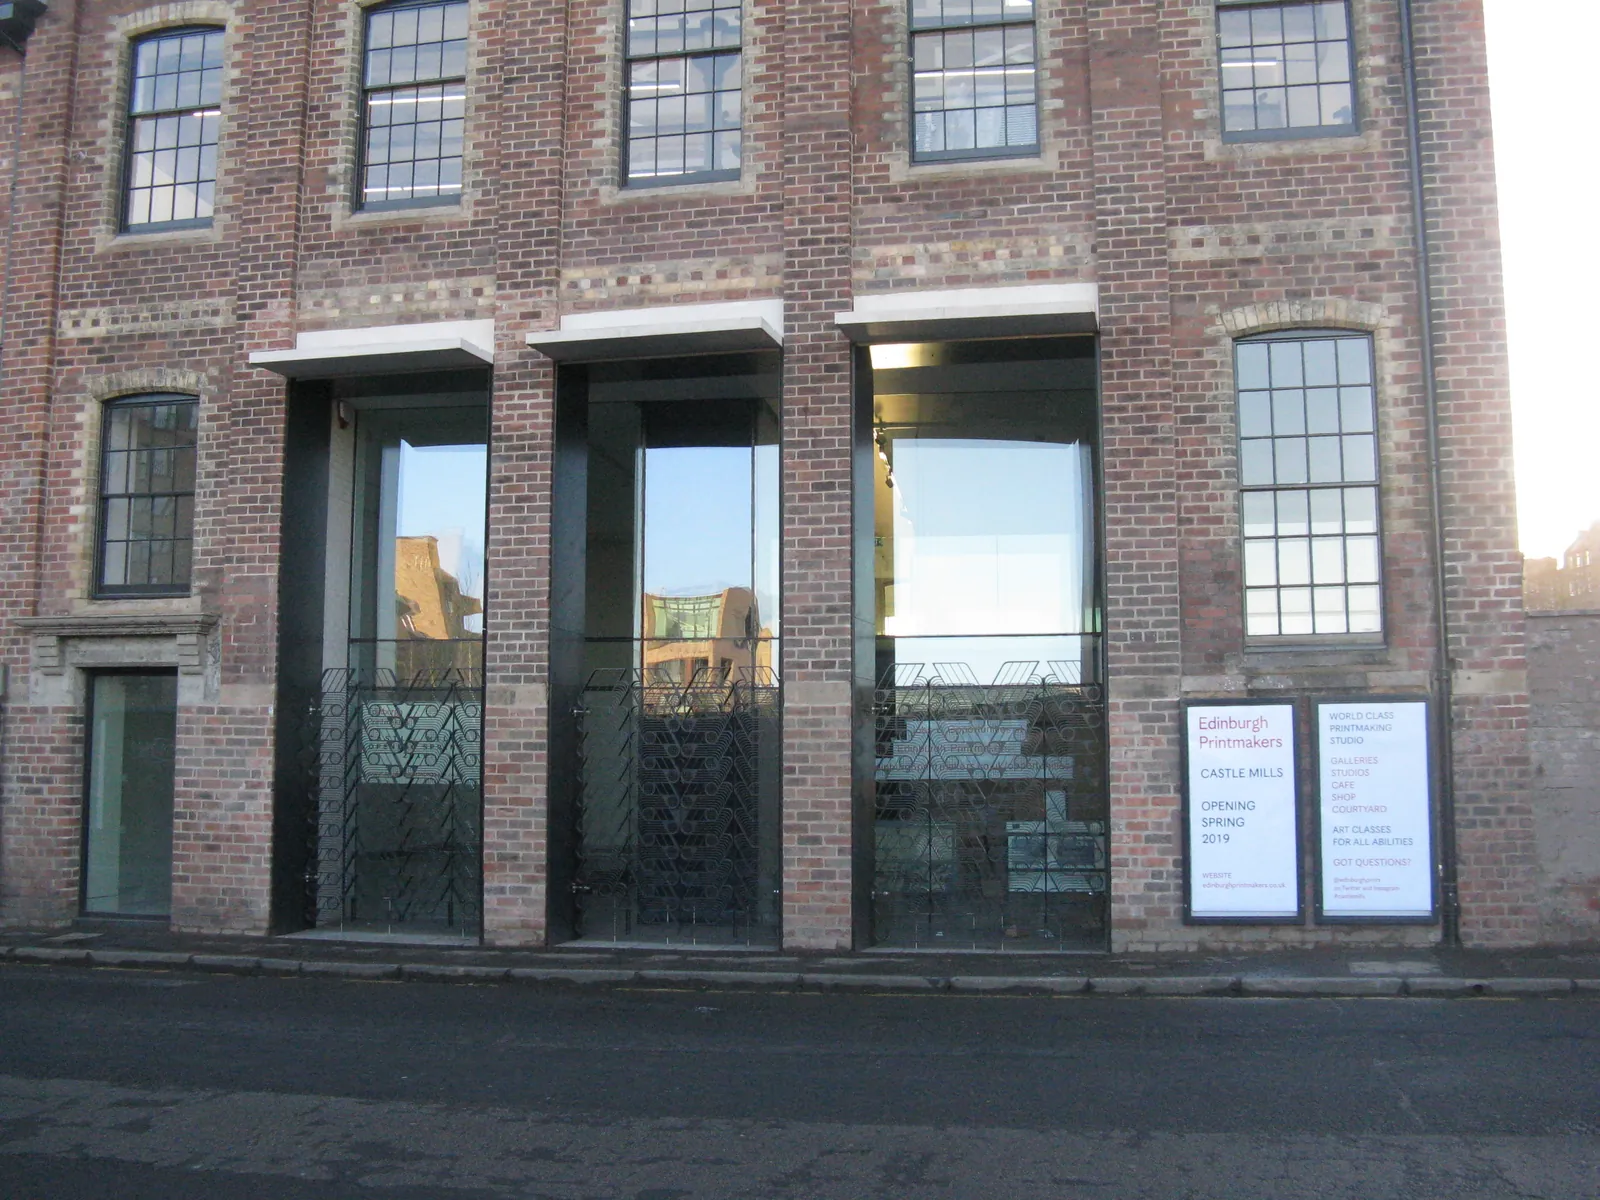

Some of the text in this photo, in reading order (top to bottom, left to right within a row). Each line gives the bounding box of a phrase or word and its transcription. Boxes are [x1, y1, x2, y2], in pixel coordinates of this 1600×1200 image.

[1329, 712, 1363, 720] WORLD
[1199, 716, 1268, 733] Edinburgh
[1330, 724, 1392, 732] PRINTMAKING
[1200, 735, 1282, 749] Printmakers
[1201, 768, 1283, 778] CASTLE MILLS
[1332, 781, 1354, 789] CAFE
[1332, 793, 1356, 801] SHOP
[1202, 801, 1255, 811] OPENING
[1332, 805, 1387, 813] COURTYARD
[1202, 817, 1244, 827] SPRING
[1202, 834, 1230, 844] 2019
[1333, 838, 1413, 846] FOR ALL ABILITIES
[1355, 858, 1411, 867] QUESTIONS?
